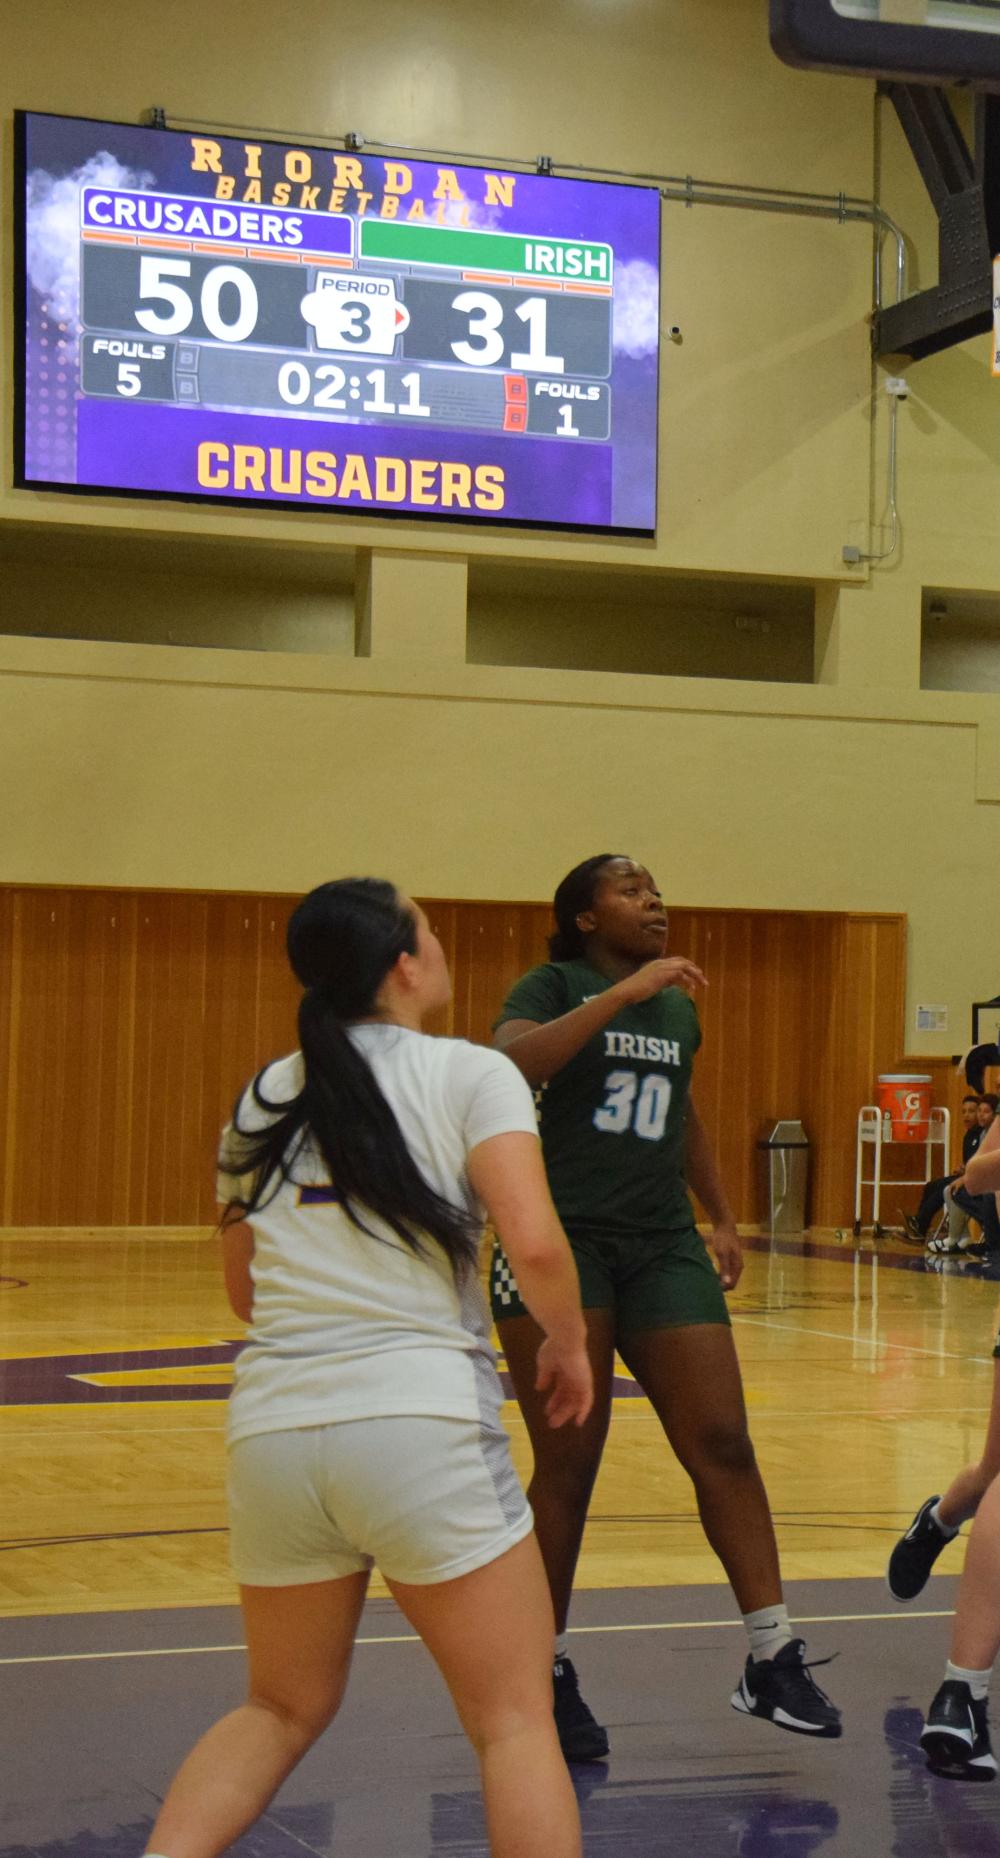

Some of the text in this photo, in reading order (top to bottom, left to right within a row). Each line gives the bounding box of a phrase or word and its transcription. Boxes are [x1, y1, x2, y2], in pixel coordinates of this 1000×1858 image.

[191, 138, 516, 207] RIORDAN
[88, 195, 303, 246] CRUSADERS
[215, 175, 471, 227] BASKETBALL
[525, 243, 607, 278] IRISH
[134, 256, 259, 342] 50
[322, 278, 390, 296] PERIOD
[339, 301, 371, 344] 3
[450, 291, 565, 374] 31
[92, 339, 166, 360] FOULS
[116, 363, 142, 397] 5
[277, 361, 431, 417] 02:11
[535, 381, 601, 401] FOULS
[556, 404, 580, 437] 1
[198, 441, 505, 511] CRUSADERS
[604, 1031, 681, 1066] IRISH
[592, 1070, 672, 1141] 30
[906, 1092, 921, 1109] G
